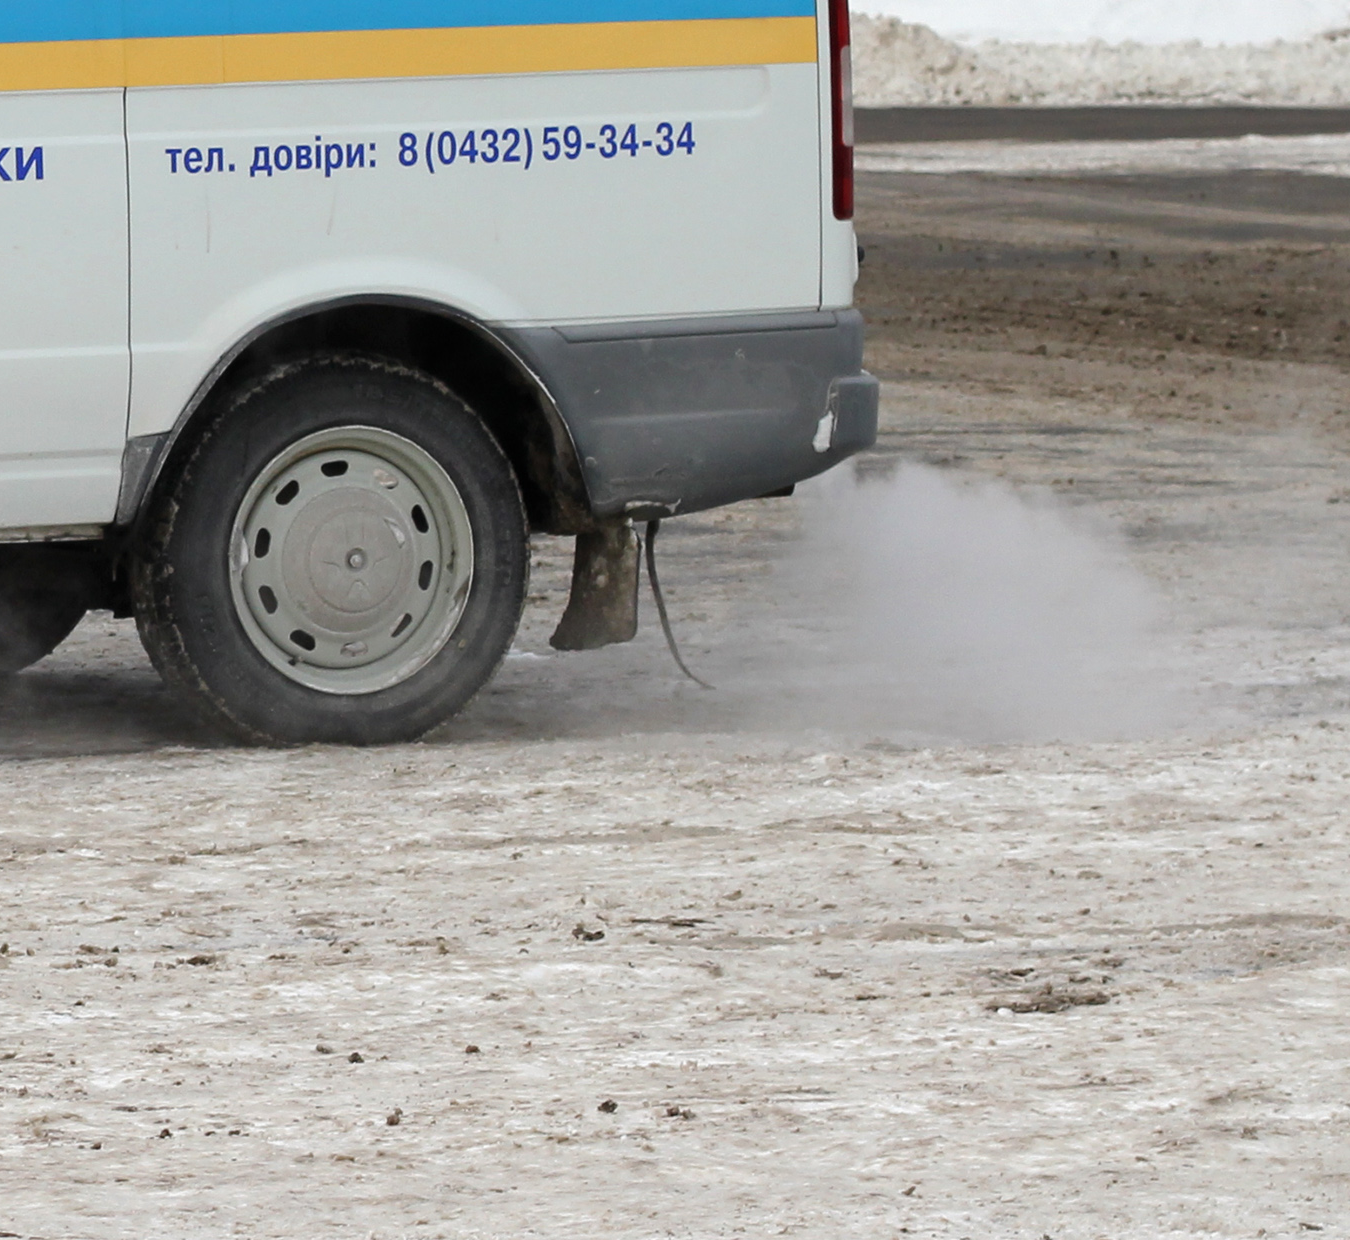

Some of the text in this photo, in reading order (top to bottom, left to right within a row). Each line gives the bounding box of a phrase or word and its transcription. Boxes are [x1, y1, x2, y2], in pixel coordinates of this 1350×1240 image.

[166, 146, 235, 173] тел.
[249, 136, 378, 177] довіри:
[542, 122, 695, 161] 59-34-34
